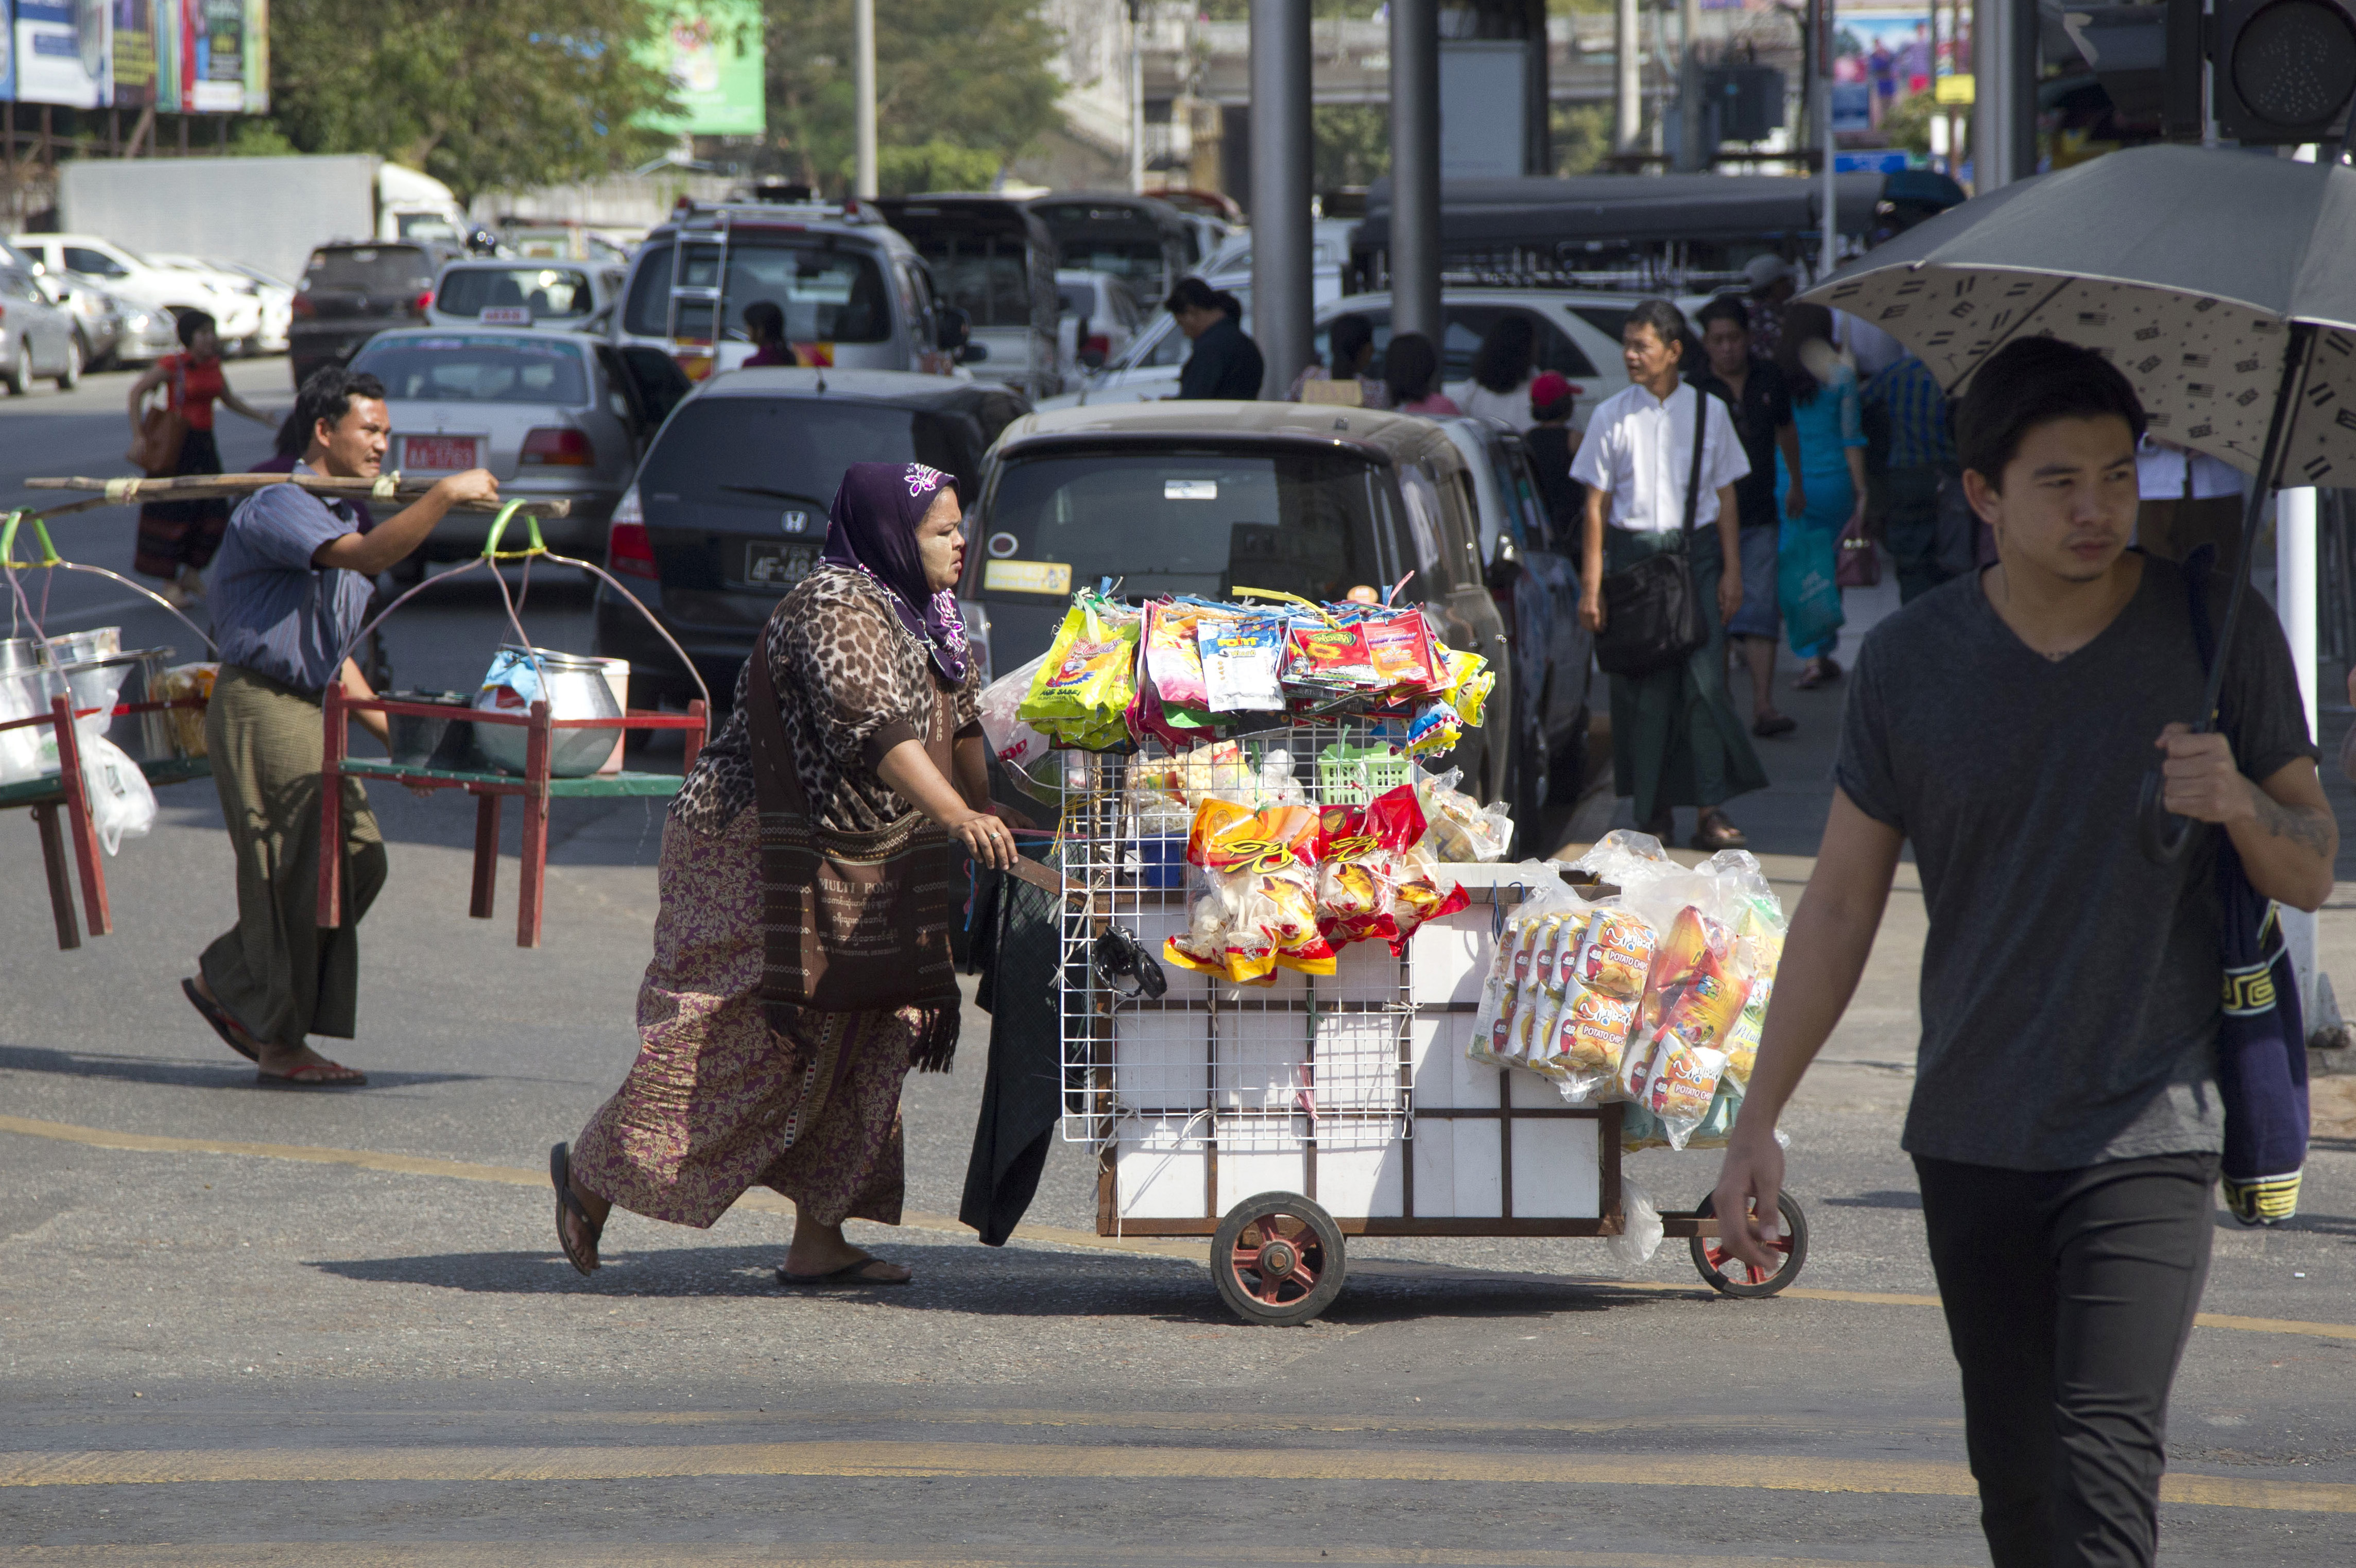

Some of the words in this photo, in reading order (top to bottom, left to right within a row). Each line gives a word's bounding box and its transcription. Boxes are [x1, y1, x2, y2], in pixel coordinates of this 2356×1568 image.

[819, 877, 855, 893] MULTI
[864, 879, 900, 894] POINT
[1609, 950, 1633, 966] POTATO
[1634, 959, 1648, 971] CHIPS
[1583, 1025, 1608, 1040] POTATO
[1609, 1033, 1624, 1045] CHIPS
[1675, 1083, 1700, 1097] POTATO
